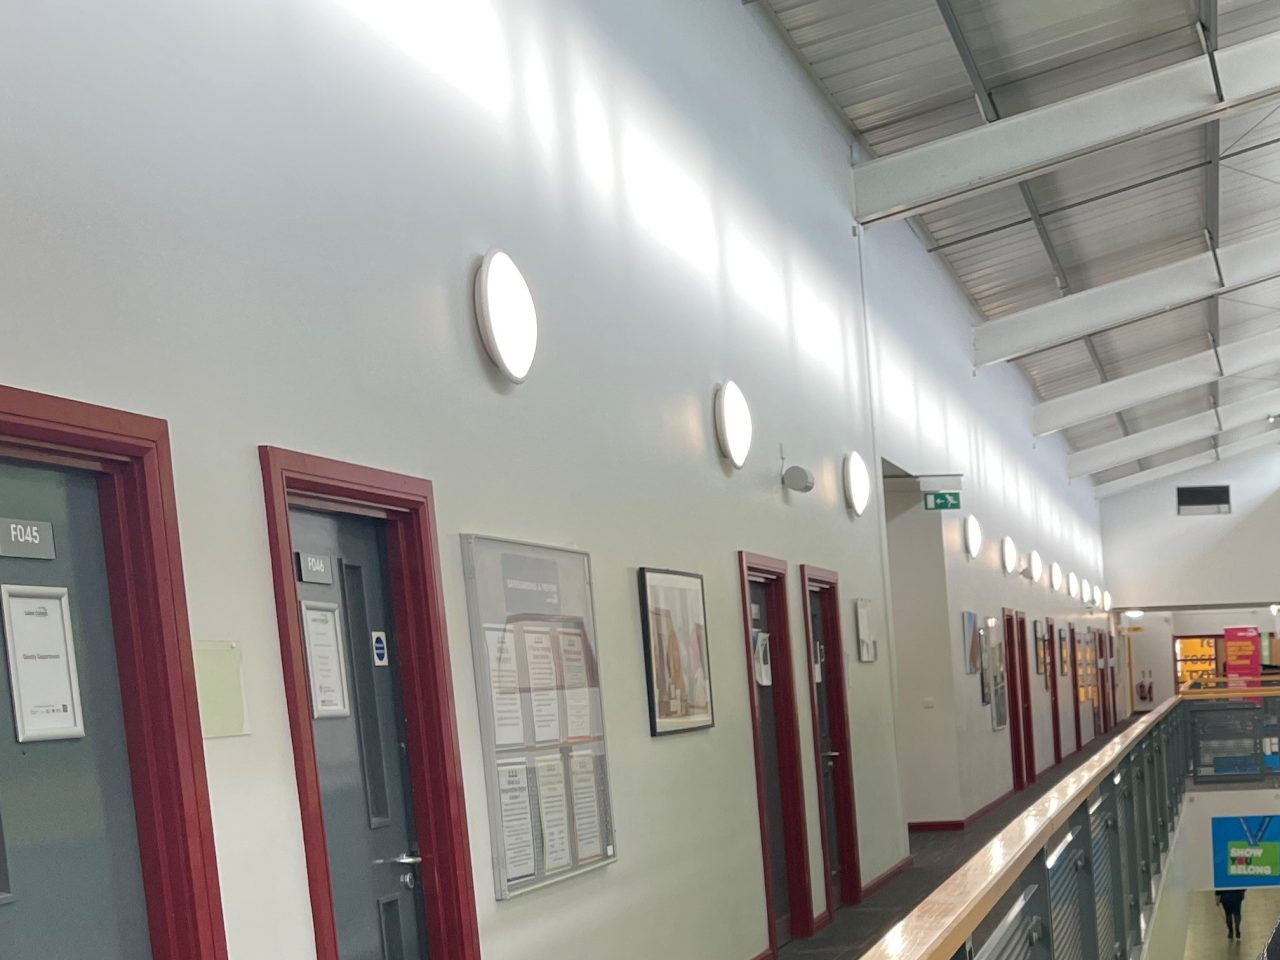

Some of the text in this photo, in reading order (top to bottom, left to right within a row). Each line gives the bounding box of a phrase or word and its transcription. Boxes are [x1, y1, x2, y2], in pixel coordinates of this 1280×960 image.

[1230, 848, 1263, 857] SHOW
[1230, 857, 1252, 866] YOU
[1230, 865, 1272, 875] BELONG
